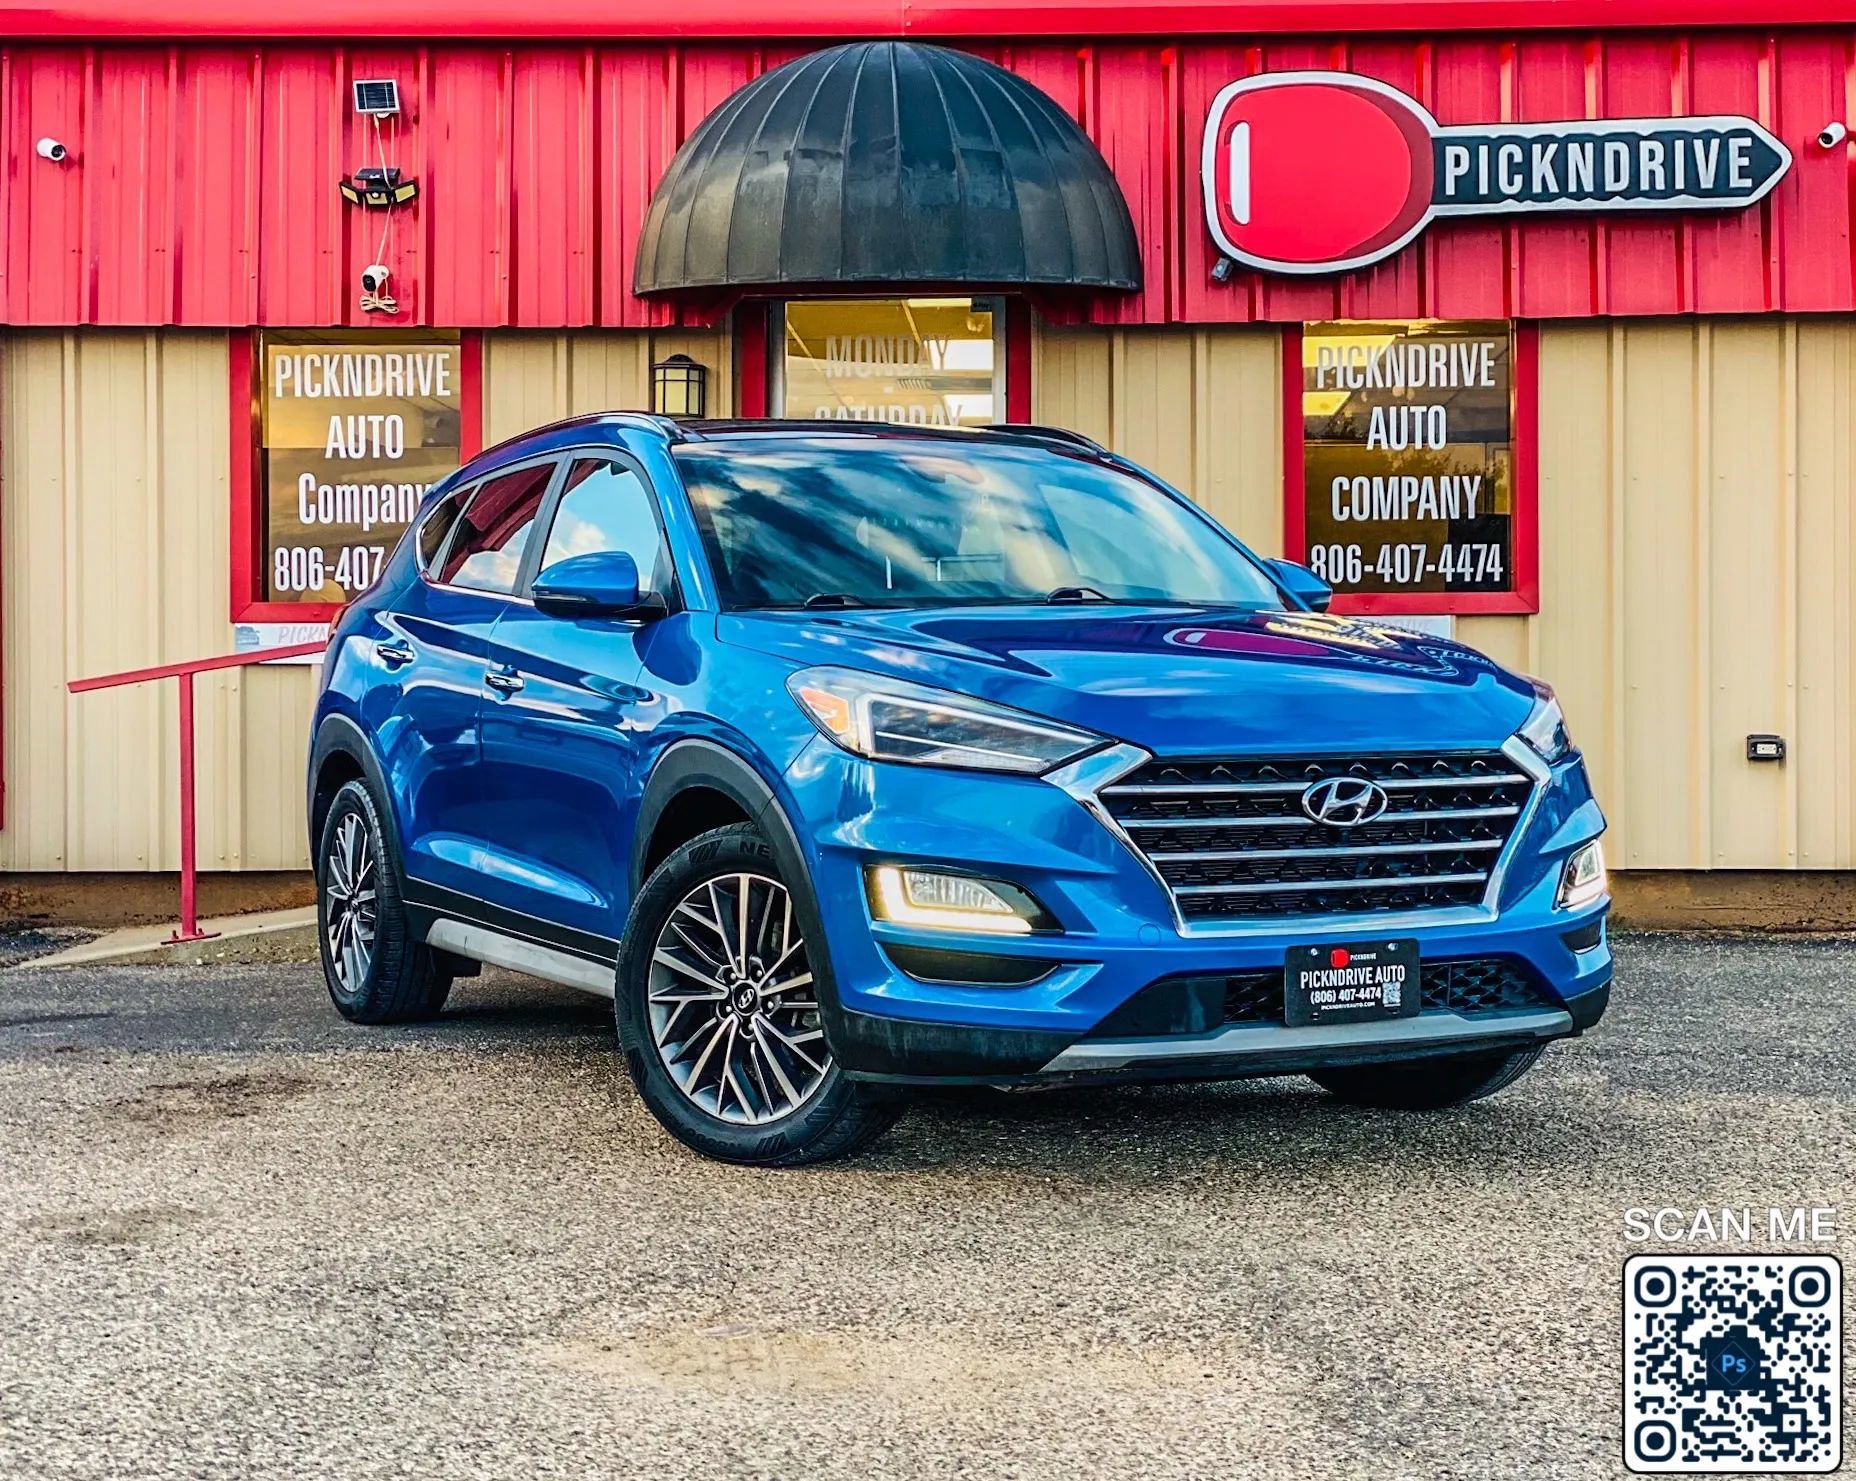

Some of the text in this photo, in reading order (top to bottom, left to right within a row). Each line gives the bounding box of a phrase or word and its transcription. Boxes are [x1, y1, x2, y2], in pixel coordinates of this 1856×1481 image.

[1445, 137, 1753, 196] PICKNDRIVE
[275, 353, 451, 398] PICKNDRIVE
[826, 335, 949, 377] MONDAY
[1317, 342, 1496, 390] PICKNDRIVE
[325, 414, 404, 459] AUTO
[1366, 404, 1447, 451] AUTO
[1331, 475, 1482, 522] COMPANY
[275, 546, 386, 592] 806-407
[1311, 543, 1504, 584] 806-407-4474
[1300, 964, 1406, 989] PICKNDRIVE AUTO
[1310, 986, 1382, 1005] (806) 407-4474
